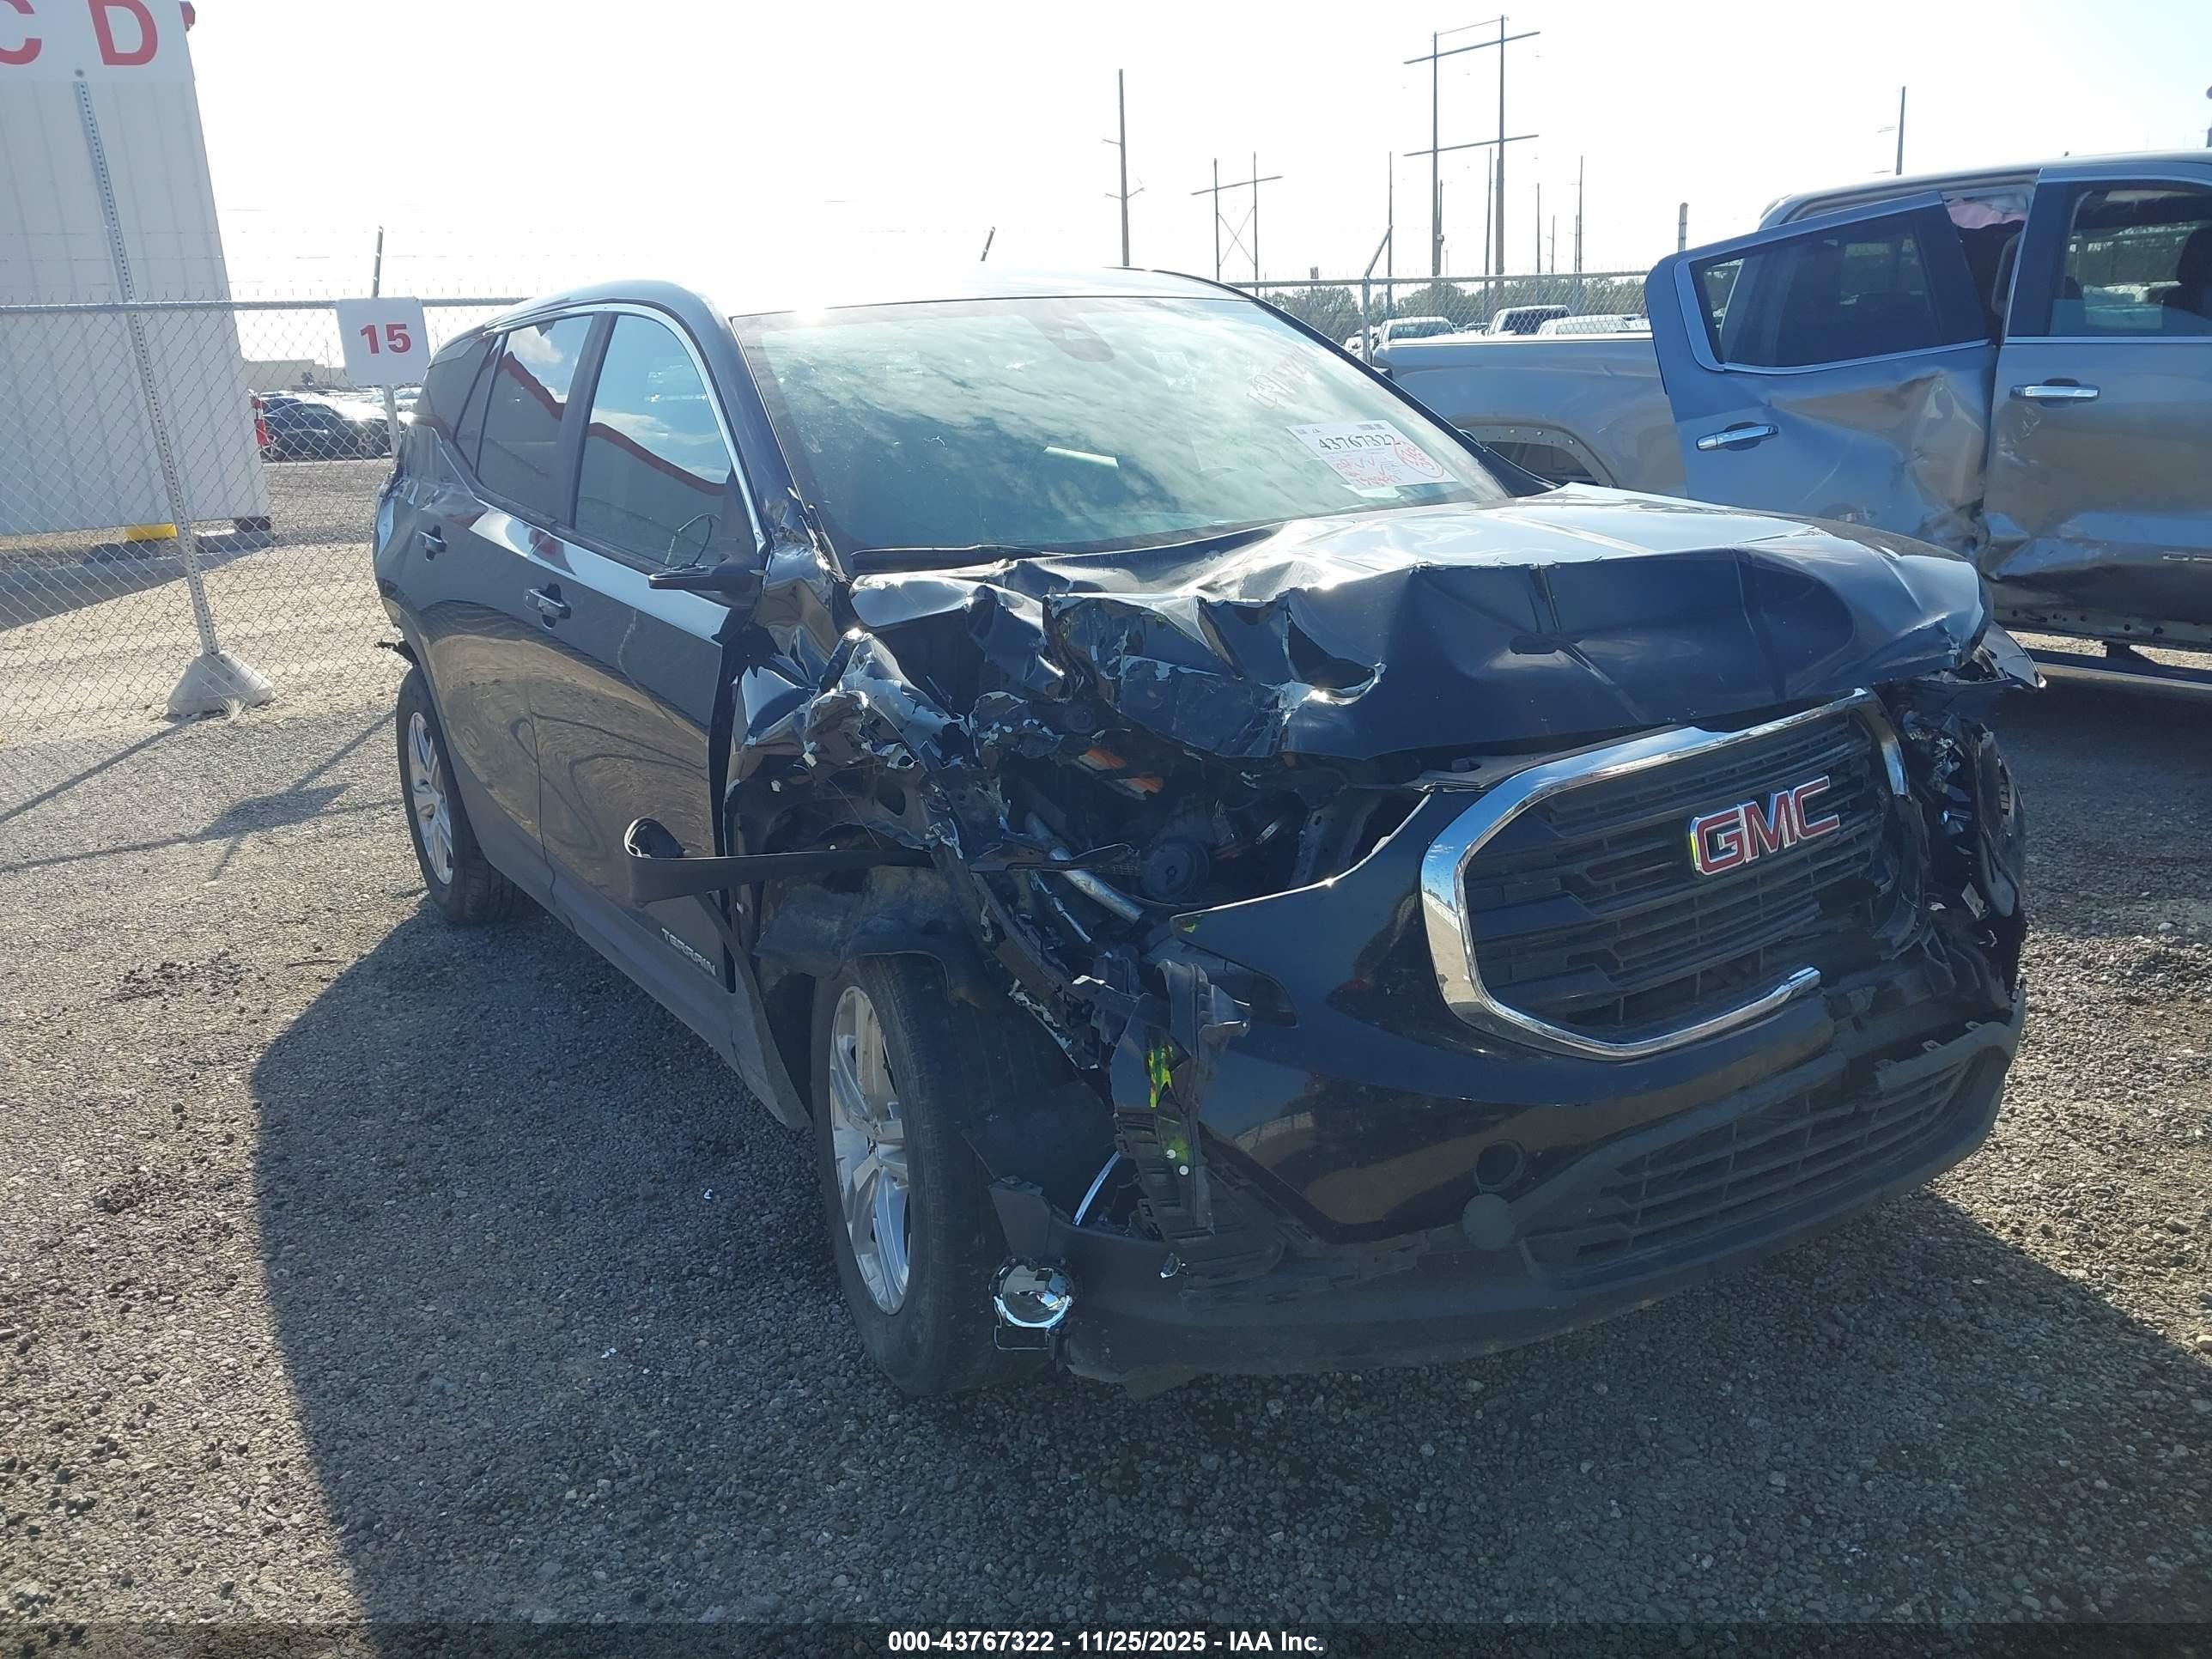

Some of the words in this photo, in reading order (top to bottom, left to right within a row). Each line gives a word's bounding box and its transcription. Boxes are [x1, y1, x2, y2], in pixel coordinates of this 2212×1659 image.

[0, 0, 42, 65] C
[88, 0, 158, 66] D
[360, 323, 411, 355] 15
[1318, 434, 1401, 451] 43767322
[1690, 775, 1841, 876] GMC
[660, 927, 717, 977] TERRAIN
